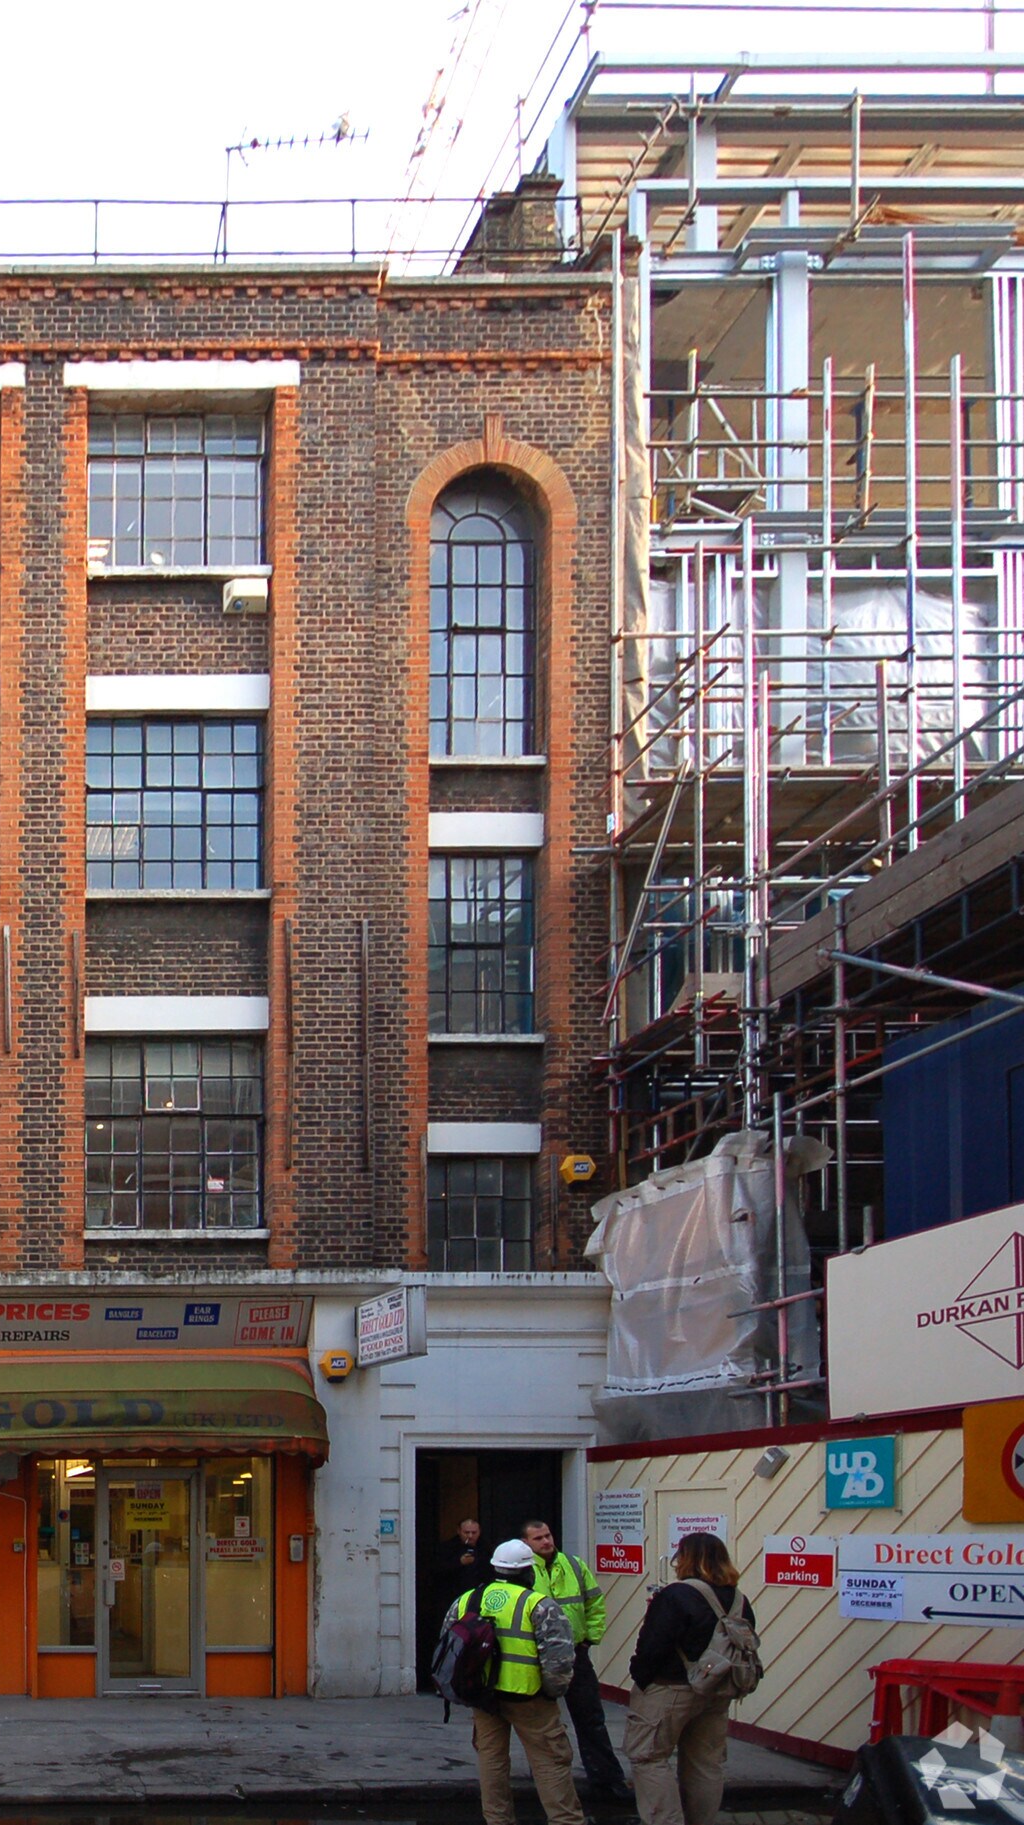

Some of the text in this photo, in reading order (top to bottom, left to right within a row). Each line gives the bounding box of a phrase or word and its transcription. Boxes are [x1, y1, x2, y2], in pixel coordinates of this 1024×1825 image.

[108, 1310, 140, 1318] BANGLES
[194, 1306, 211, 1315] EAR
[252, 1307, 287, 1321] PLEASE
[917, 1296, 1010, 1329] DURKAN
[188, 1314, 215, 1323] RINGS
[0, 1330, 70, 1342] REPAIRS
[138, 1329, 177, 1338] BRACELETS
[240, 1326, 295, 1341] COME IN
[331, 1359, 346, 1368] ADT
[233, 1413, 285, 1428] LTD
[612, 1547, 625, 1557] No
[875, 1543, 953, 1565] Direct
[600, 1558, 639, 1572] Smoking
[790, 1556, 806, 1566] No
[777, 1571, 819, 1584] parking
[846, 1578, 897, 1589] SUNDAY
[949, 1583, 1024, 1604] OPEN
[850, 1600, 893, 1608] DECEMBER
